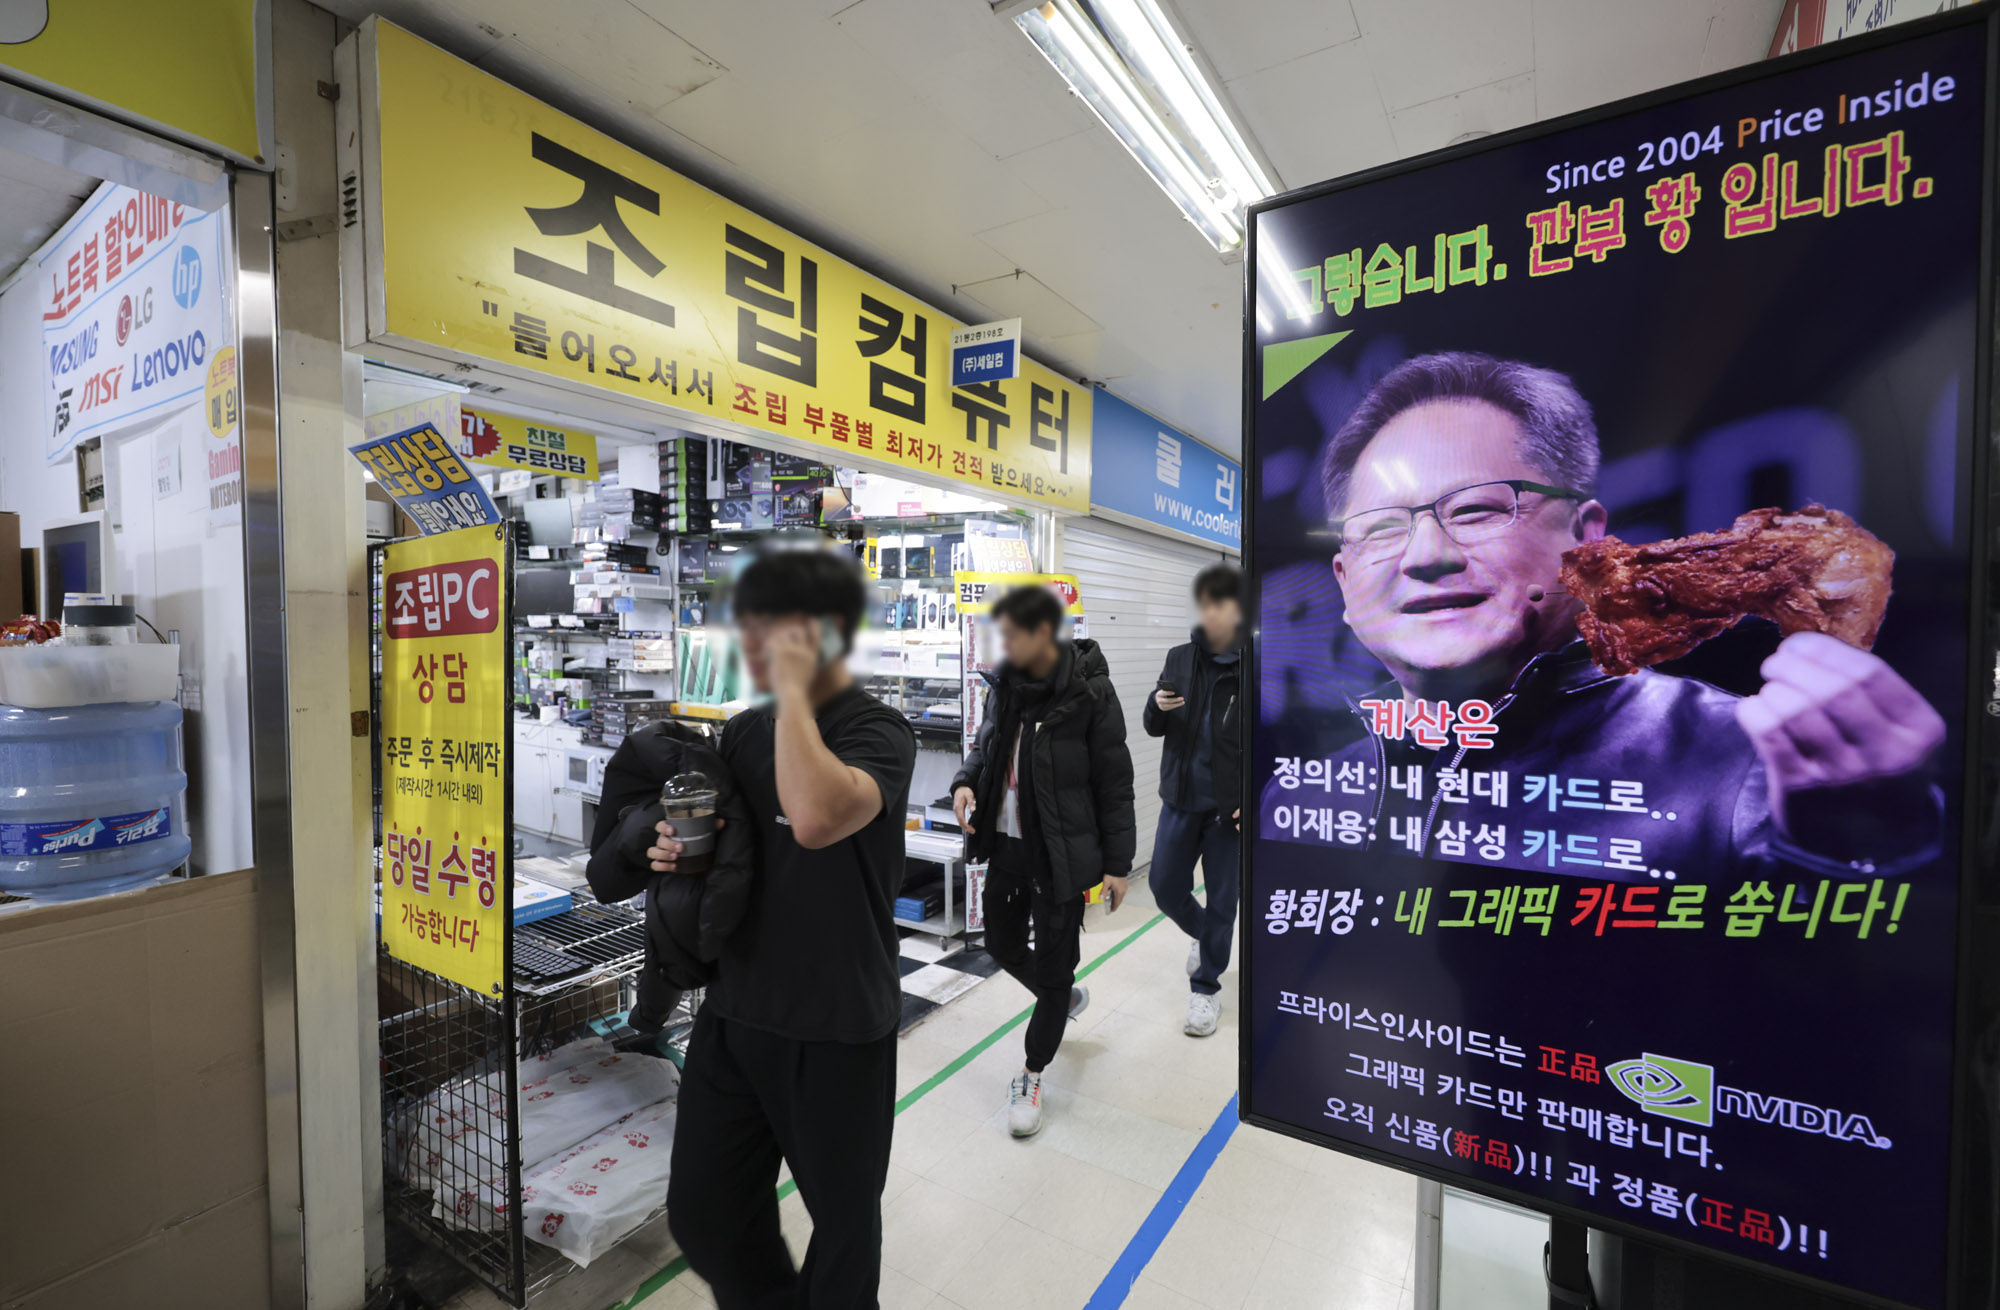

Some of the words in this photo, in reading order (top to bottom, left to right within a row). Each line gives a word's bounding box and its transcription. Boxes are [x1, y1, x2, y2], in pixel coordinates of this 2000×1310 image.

[1546, 152, 1625, 194] Since
[1636, 125, 1724, 173] 2004
[1737, 106, 1824, 148] Price
[1837, 70, 1956, 125] Inside
[1286, 224, 1507, 319] 그렇습니다.
[1526, 197, 1626, 277] 깐부
[1645, 171, 1701, 254] 황
[1720, 129, 1933, 240] 입니다.
[42, 233, 99, 321] 노트북
[174, 246, 201, 310] hp
[78, 364, 124, 413] msi
[131, 329, 206, 392] Lenovo
[962, 352, 1004, 373] (주)세일컴
[356, 428, 471, 497] 조립상담
[508, 444, 588, 475] 무료상담
[526, 426, 566, 450] 친절
[732, 382, 787, 426] 조립
[803, 402, 873, 449] 부품별
[886, 429, 943, 469] 최저가
[952, 450, 983, 481] 견적
[392, 568, 490, 631] 조립PC
[412, 652, 467, 704] 상담
[1360, 699, 1499, 749] 계산은
[386, 737, 413, 767] 주문
[419, 737, 434, 769] 후
[440, 739, 500, 777] 즉시제작
[395, 776, 433, 798] (제작시간
[437, 780, 459, 801] 1시간
[462, 783, 482, 805] 내외)
[1273, 757, 1377, 795] 정의선:
[1390, 764, 1423, 801] 내
[1435, 766, 1509, 807] 현대
[1522, 773, 1678, 822] 카드로..
[42, 826, 96, 855] Puriss
[387, 829, 432, 895] 당일
[437, 837, 497, 909] 수령
[1273, 805, 1377, 845] 이재용:
[1390, 816, 1423, 852] 내
[1434, 820, 1506, 862] 삼성
[1521, 829, 1677, 880] 카드로..
[401, 903, 479, 953] 가능합니다
[1265, 888, 1364, 936] 황회장
[1394, 886, 1432, 936] 내
[1437, 884, 1560, 936] 그래픽
[1570, 883, 1707, 937] 카드로
[1723, 879, 1911, 939] 쏩니다!
[1277, 990, 1526, 1069] 프라이스인사이드는
[1537, 1045, 1600, 1084] 正品
[1345, 1052, 1425, 1097] 그래픽
[1437, 1073, 1527, 1121] 카드만
[1537, 1097, 1724, 1171] 판매합니다.
[1323, 1096, 1375, 1134] 오직
[1566, 1161, 1600, 1196] 과
